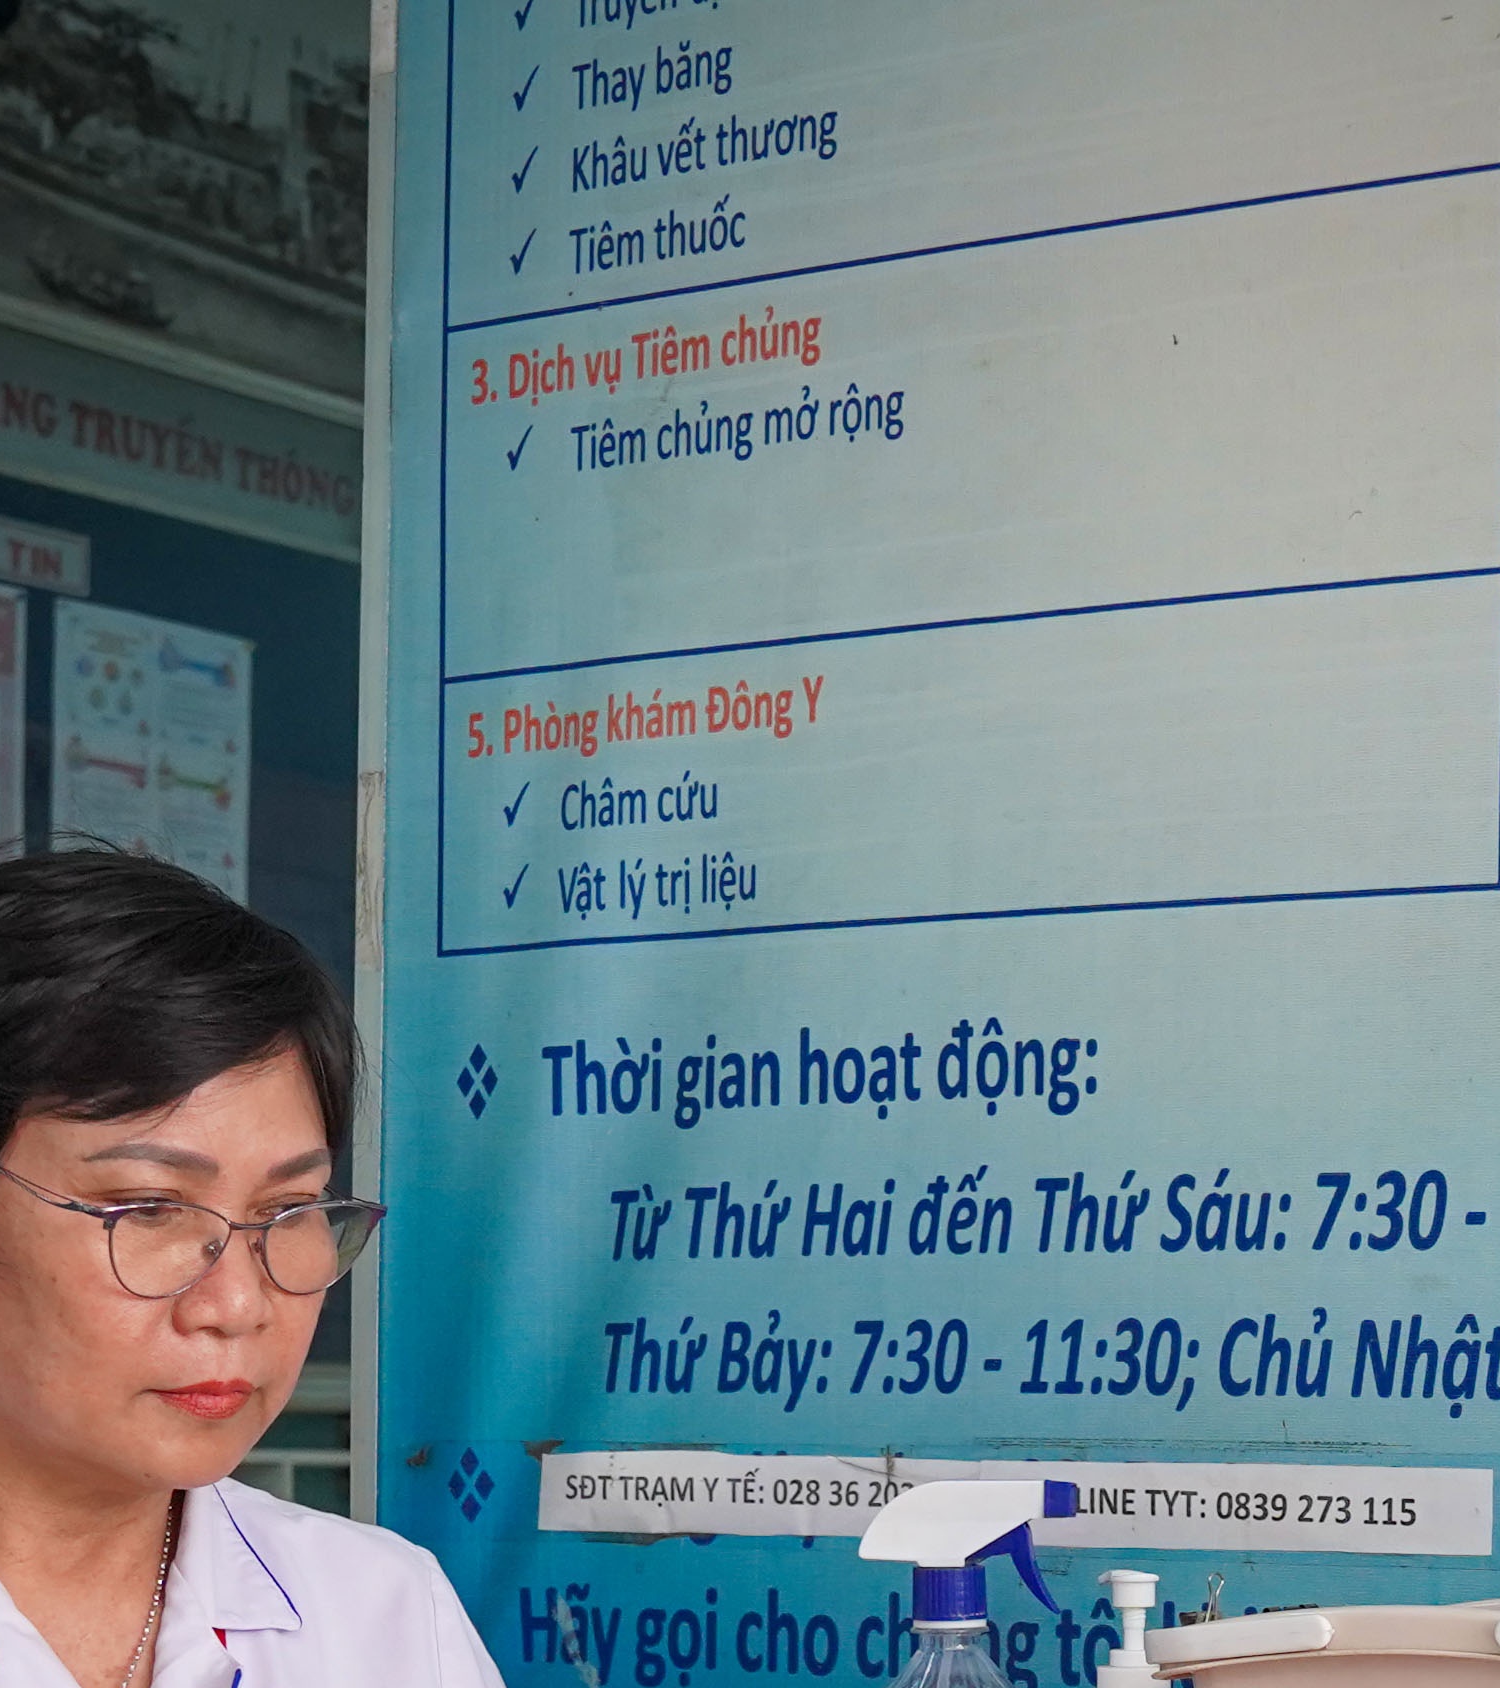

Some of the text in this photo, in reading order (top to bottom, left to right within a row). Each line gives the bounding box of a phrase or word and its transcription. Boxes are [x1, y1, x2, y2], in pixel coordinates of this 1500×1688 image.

[572, 42, 733, 113] Thay băng
[571, 110, 838, 193] Khâu vết thương
[570, 194, 747, 275] Tiêm thuốc
[470, 306, 822, 407] 3. Dịch vụ Tiêm chủng
[571, 384, 905, 473] Tiêm chủng mở rộng
[9, 538, 64, 579] TIN
[467, 675, 824, 759] 5. Phòng khám Đông Y
[561, 770, 719, 831] Châm cứu
[559, 851, 757, 925] Vật lý trị liệu
[542, 1017, 1099, 1129] Thời gian hoạt động:
[610, 1187, 672, 1262] Từ
[683, 1180, 788, 1260] Thứ
[801, 1178, 895, 1257] Hai
[909, 1165, 1012, 1256] đến
[1032, 1167, 1147, 1253] Thứ
[1160, 1167, 1291, 1252] Sáu:
[1313, 1169, 1446, 1252] 7:30
[604, 1318, 707, 1397] Thứ
[718, 1312, 831, 1414] Bảy:
[851, 1318, 969, 1397] 7:30
[1019, 1317, 1201, 1412] 11:30;
[1217, 1306, 1332, 1399] Chủ
[566, 1475, 613, 1500] SĐT
[619, 1476, 694, 1507] TRẠM
[703, 1477, 718, 1502] Y
[728, 1468, 765, 1504] TẾ:
[773, 1479, 819, 1506] 028
[829, 1480, 859, 1507] 36
[1144, 1488, 1206, 1520] TYT:
[1215, 1490, 1287, 1523] 0839
[1297, 1492, 1351, 1525] 273
[1361, 1494, 1416, 1527] 115
[519, 1584, 621, 1686] Hãy
[635, 1586, 718, 1687] gọi
[735, 1588, 839, 1676] cho
